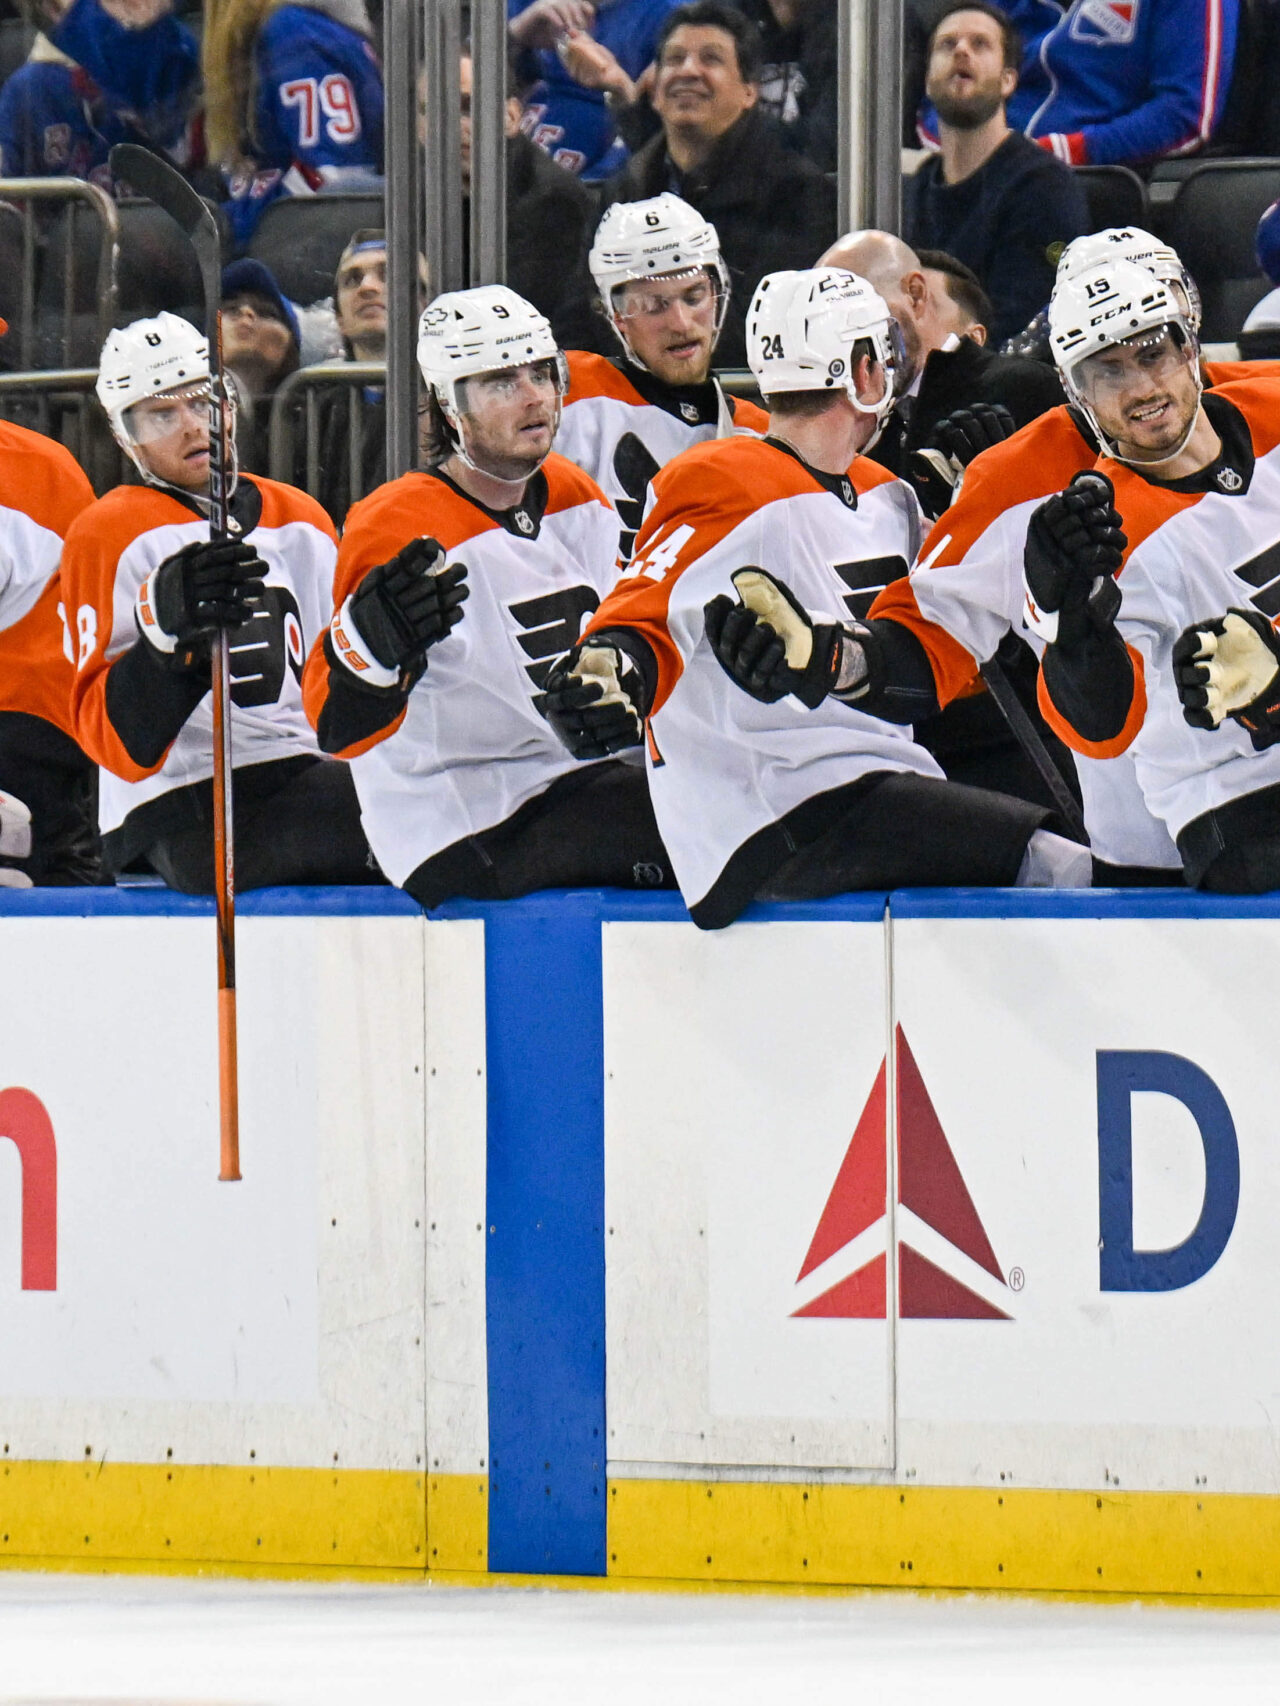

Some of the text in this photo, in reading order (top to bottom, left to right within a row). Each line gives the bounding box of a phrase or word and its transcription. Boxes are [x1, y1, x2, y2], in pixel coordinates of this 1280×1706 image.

[279, 73, 362, 147] 79
[645, 211, 660, 226] 6
[492, 304, 510, 319] 9
[1090, 302, 1132, 327] CCM
[145, 332, 161, 346] 8
[496, 332, 533, 345] BAUER
[761, 334, 785, 360] 24
